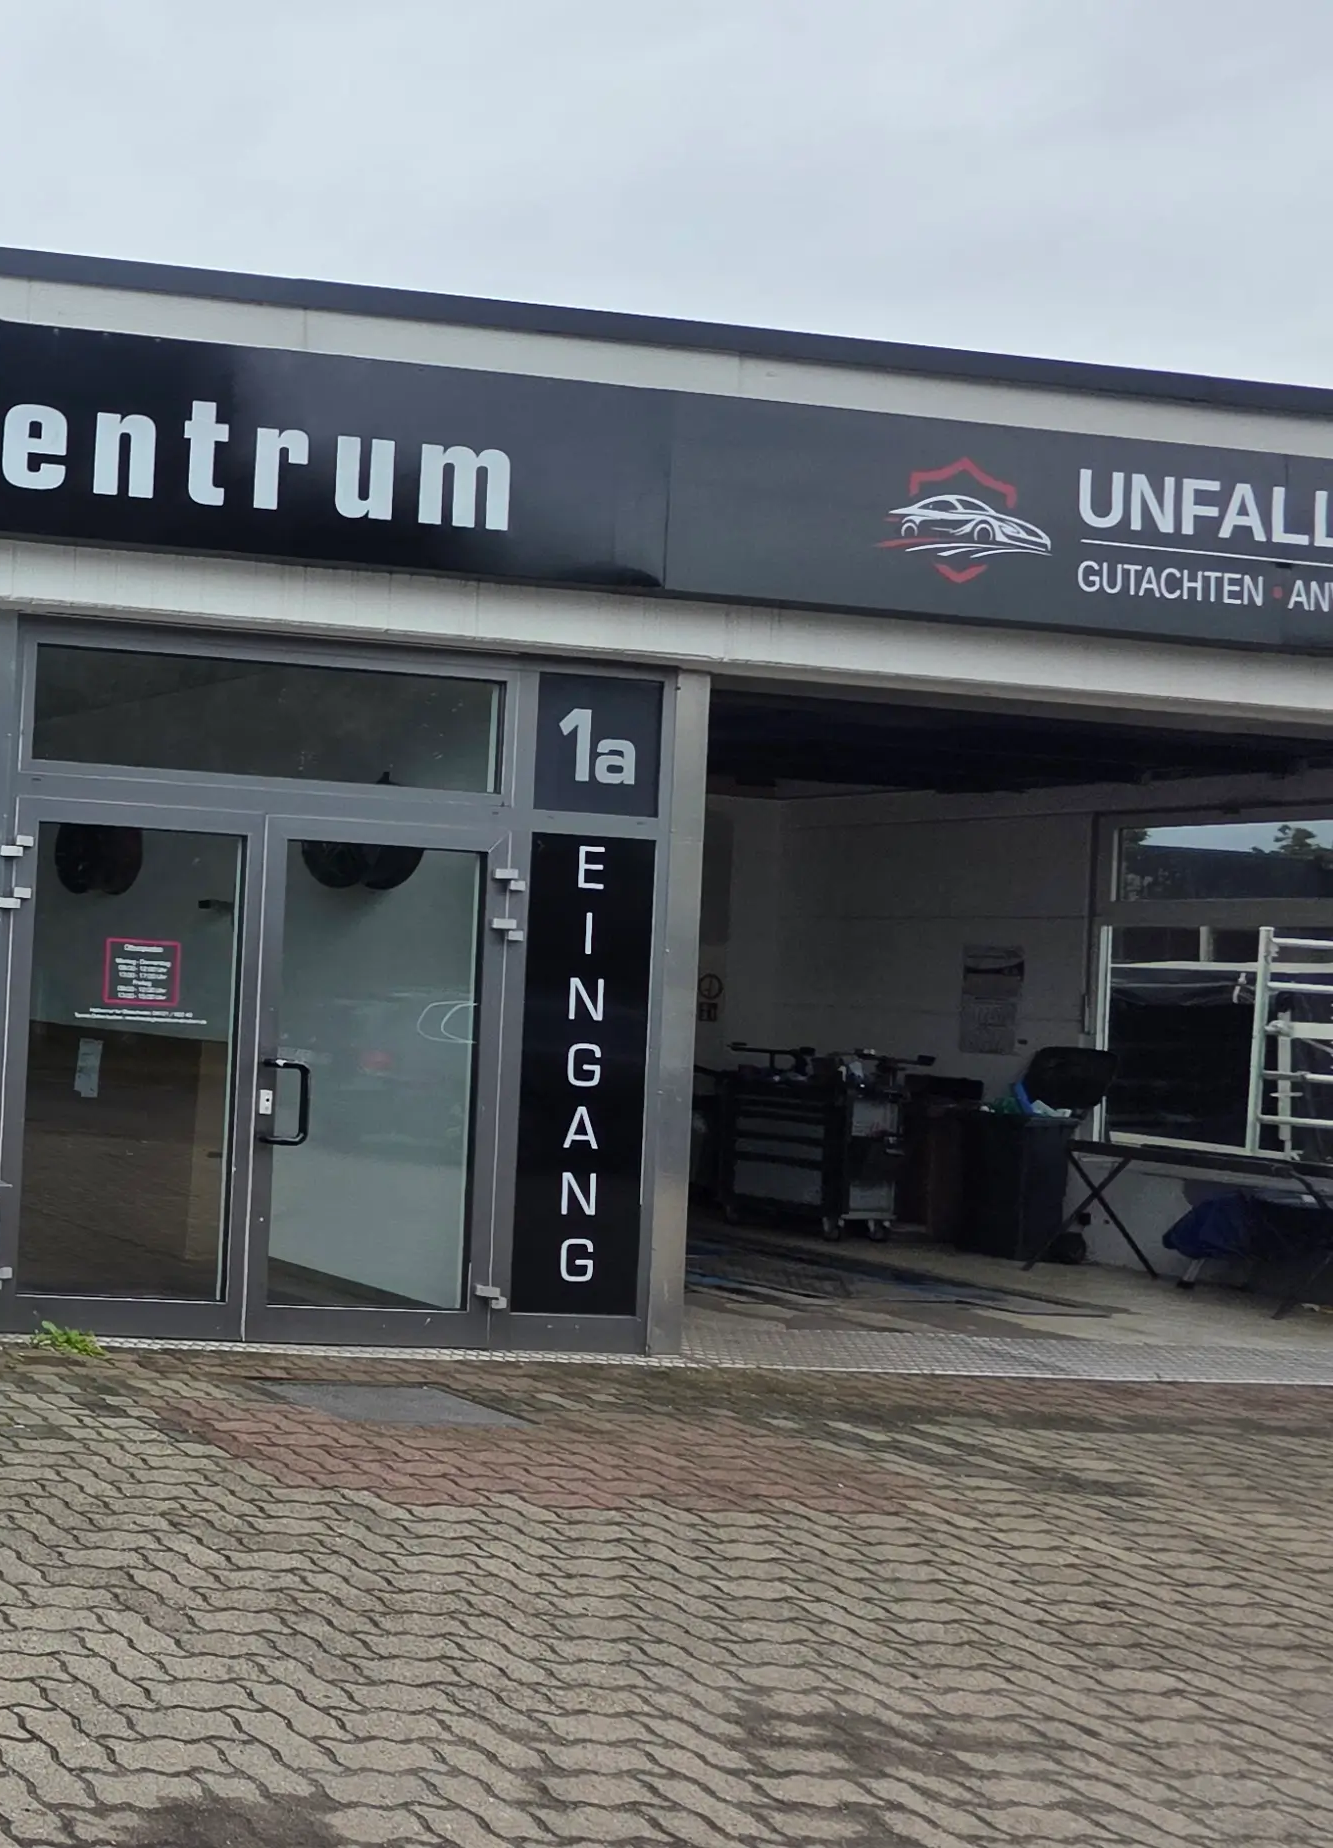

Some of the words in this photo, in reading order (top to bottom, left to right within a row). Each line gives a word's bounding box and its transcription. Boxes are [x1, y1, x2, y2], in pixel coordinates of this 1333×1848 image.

[1077, 560, 1264, 606] GUTACHTEN
[1288, 579, 1333, 613] AN
[559, 708, 636, 785] 1a
[559, 846, 606, 1283] EINGANG
